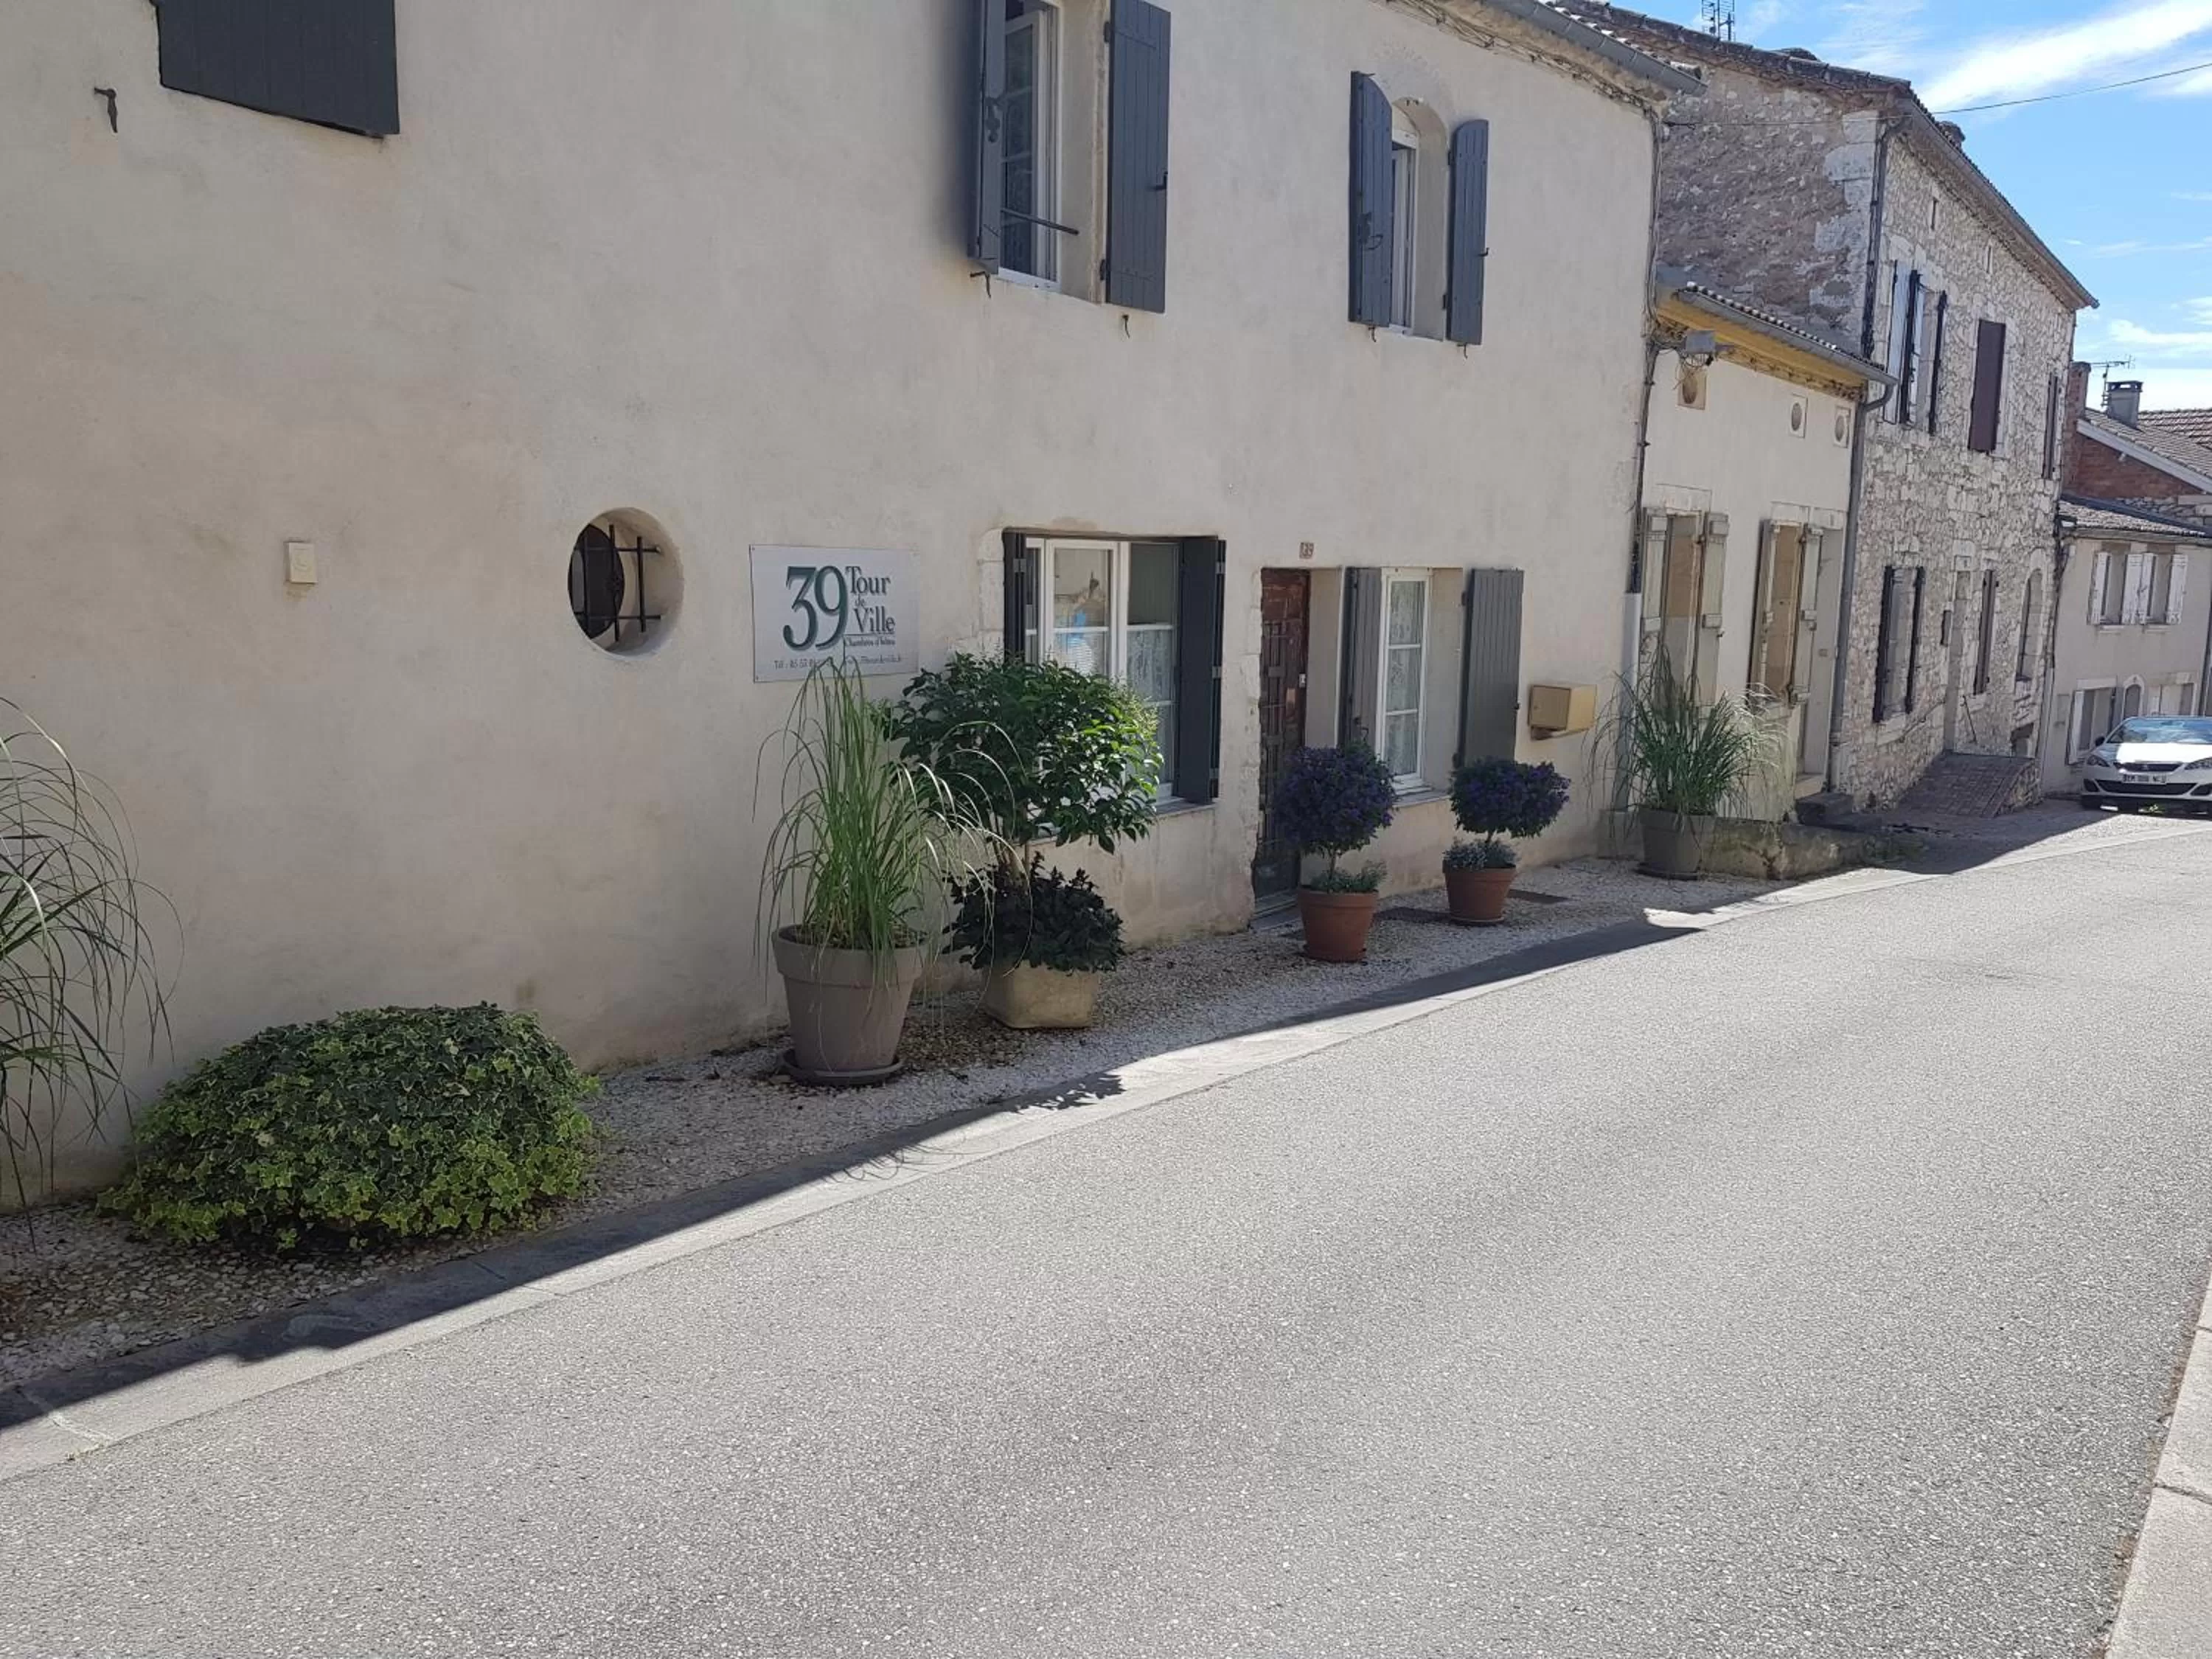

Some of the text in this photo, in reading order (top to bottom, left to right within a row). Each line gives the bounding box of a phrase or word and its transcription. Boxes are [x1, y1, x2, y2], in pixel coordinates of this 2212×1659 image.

[845, 566, 891, 595] Tour
[783, 566, 847, 650] 39
[855, 594, 866, 607] de
[853, 605, 896, 634] Ville
